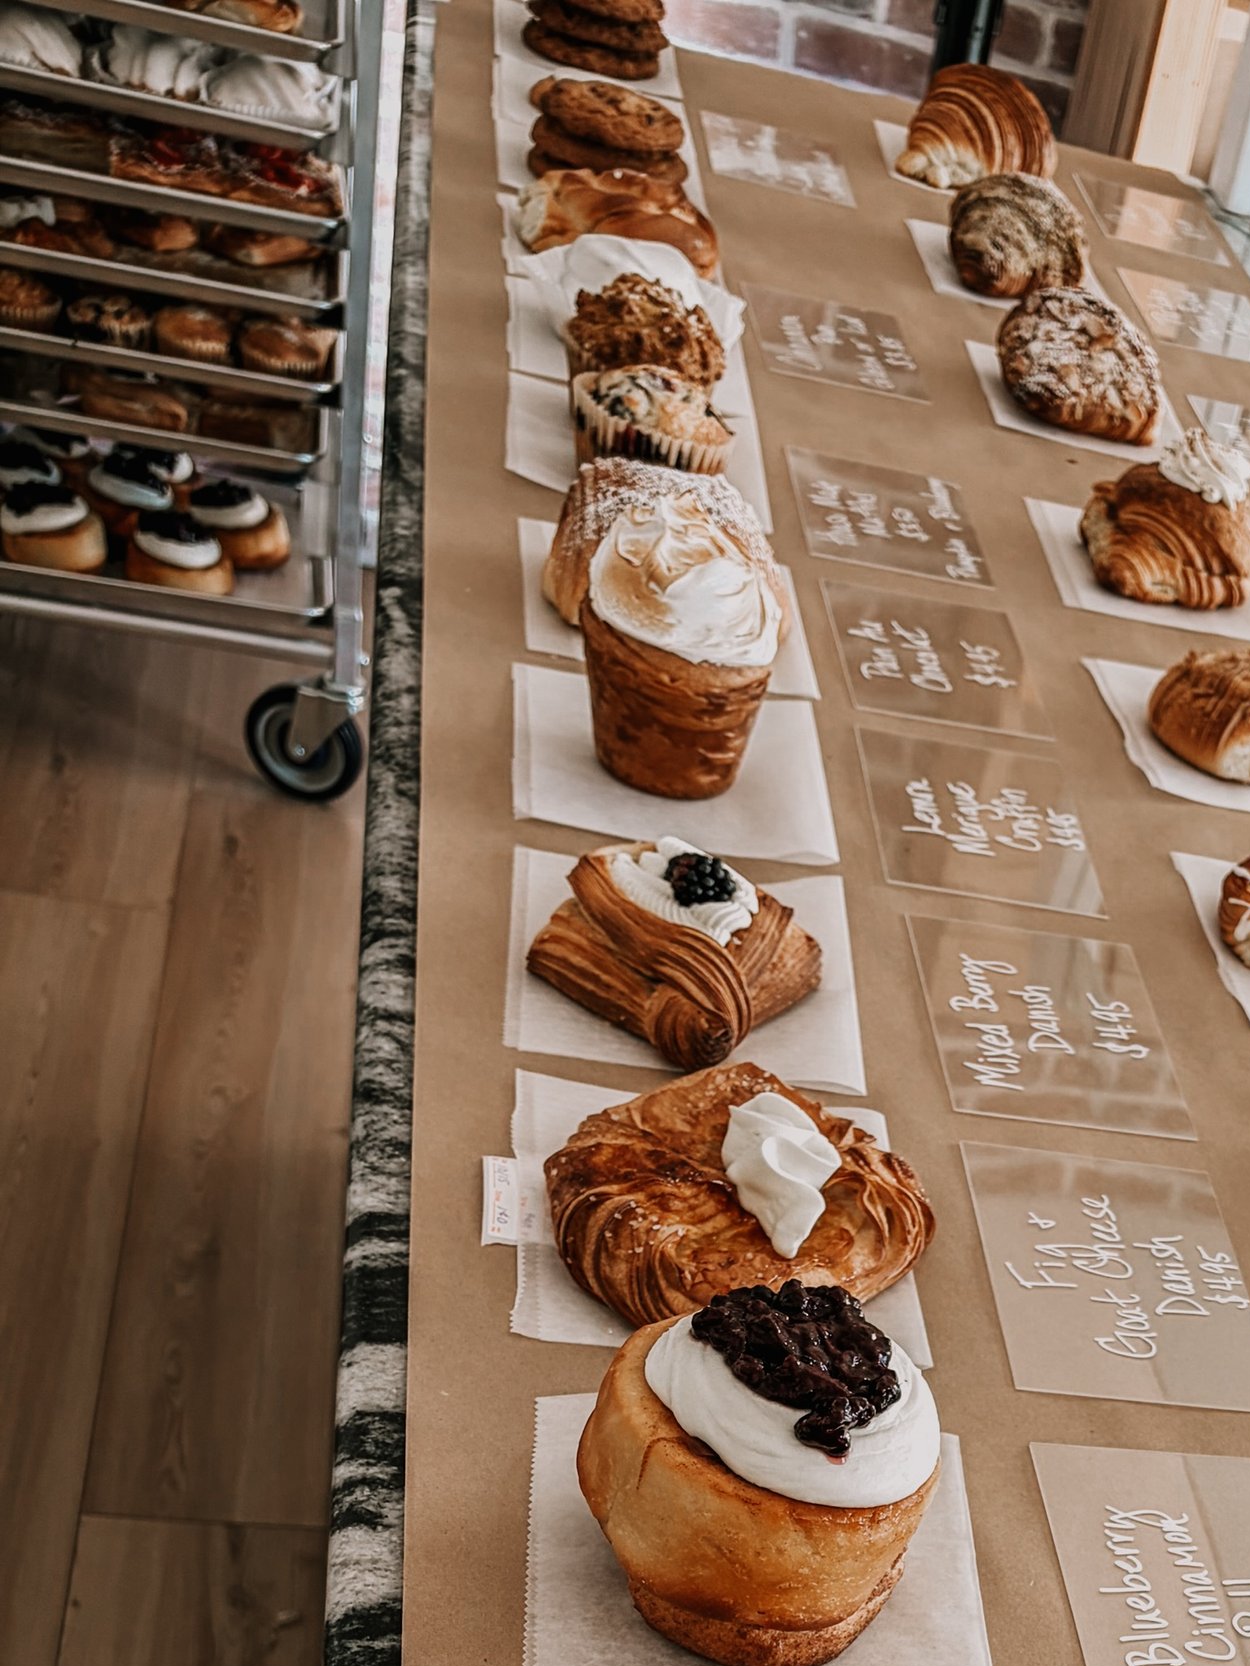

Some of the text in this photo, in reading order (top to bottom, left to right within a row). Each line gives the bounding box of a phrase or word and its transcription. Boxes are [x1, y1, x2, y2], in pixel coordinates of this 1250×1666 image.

[949, 953, 1024, 1091] Mixed Berry
[1008, 985, 1076, 1055] Danish
[1086, 992, 1150, 1059] $4.95
[1005, 1243, 1104, 1289] Fig
[1072, 1194, 1158, 1359] Goat Cheese
[1133, 1235, 1211, 1316] Danish
[1161, 1513, 1237, 1661] Cinnamon
